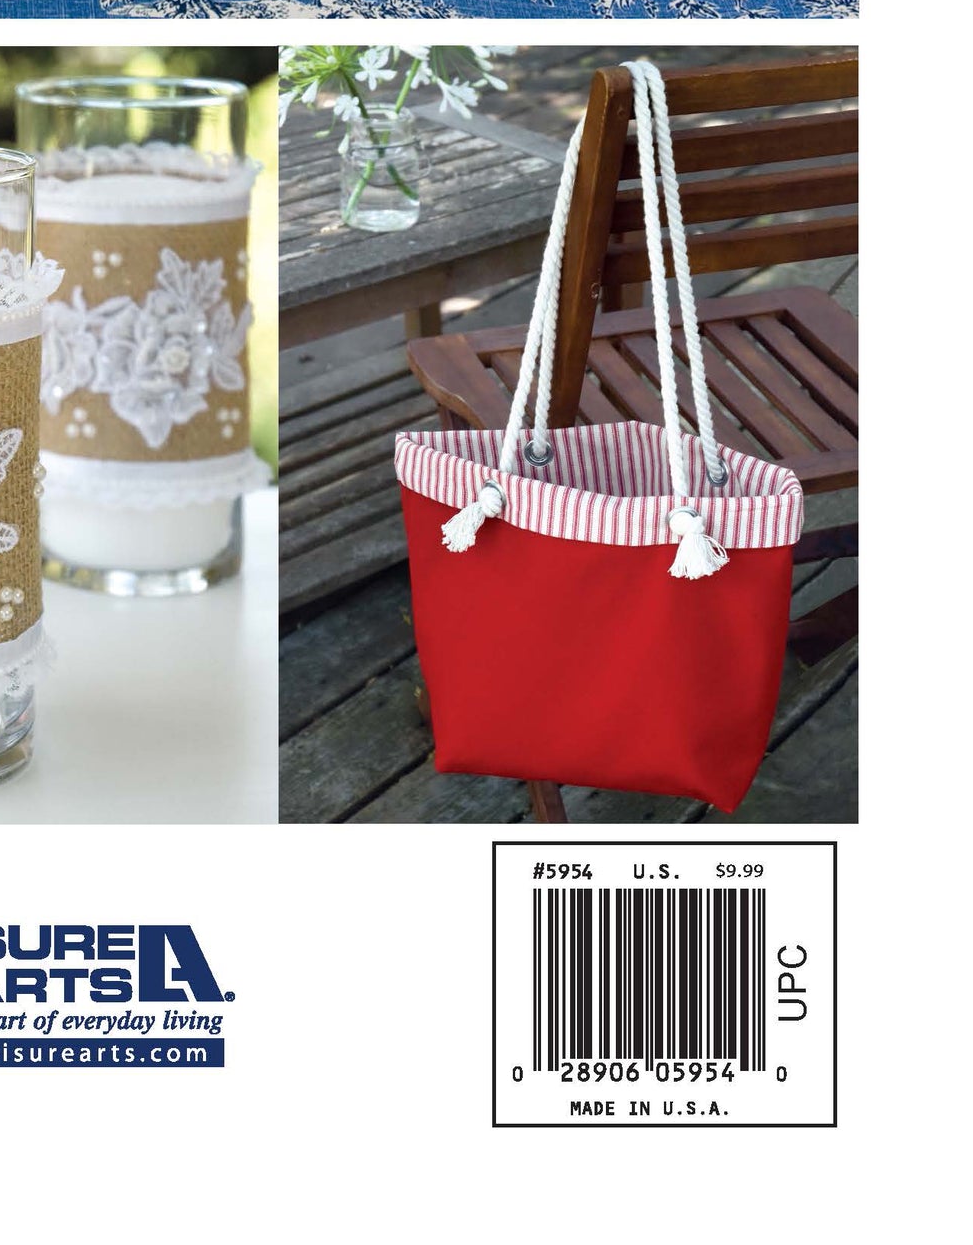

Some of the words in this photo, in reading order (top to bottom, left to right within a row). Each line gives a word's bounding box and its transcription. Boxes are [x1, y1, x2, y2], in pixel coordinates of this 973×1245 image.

[532, 862, 593, 880] #5954
[633, 863, 679, 880] U.S.
[715, 862, 764, 879] $9.99
[777, 944, 808, 1022] UPC
[33, 1009, 60, 1035] of
[62, 1009, 156, 1035] everyday
[162, 1009, 224, 1035] living
[512, 1065, 524, 1083] 0
[561, 1062, 640, 1083] 28906
[655, 1062, 735, 1083] 05954
[776, 1065, 788, 1083] 0
[570, 1100, 615, 1116] MADE
[629, 1100, 651, 1116] IN
[663, 1100, 729, 1116] U.S.A.
